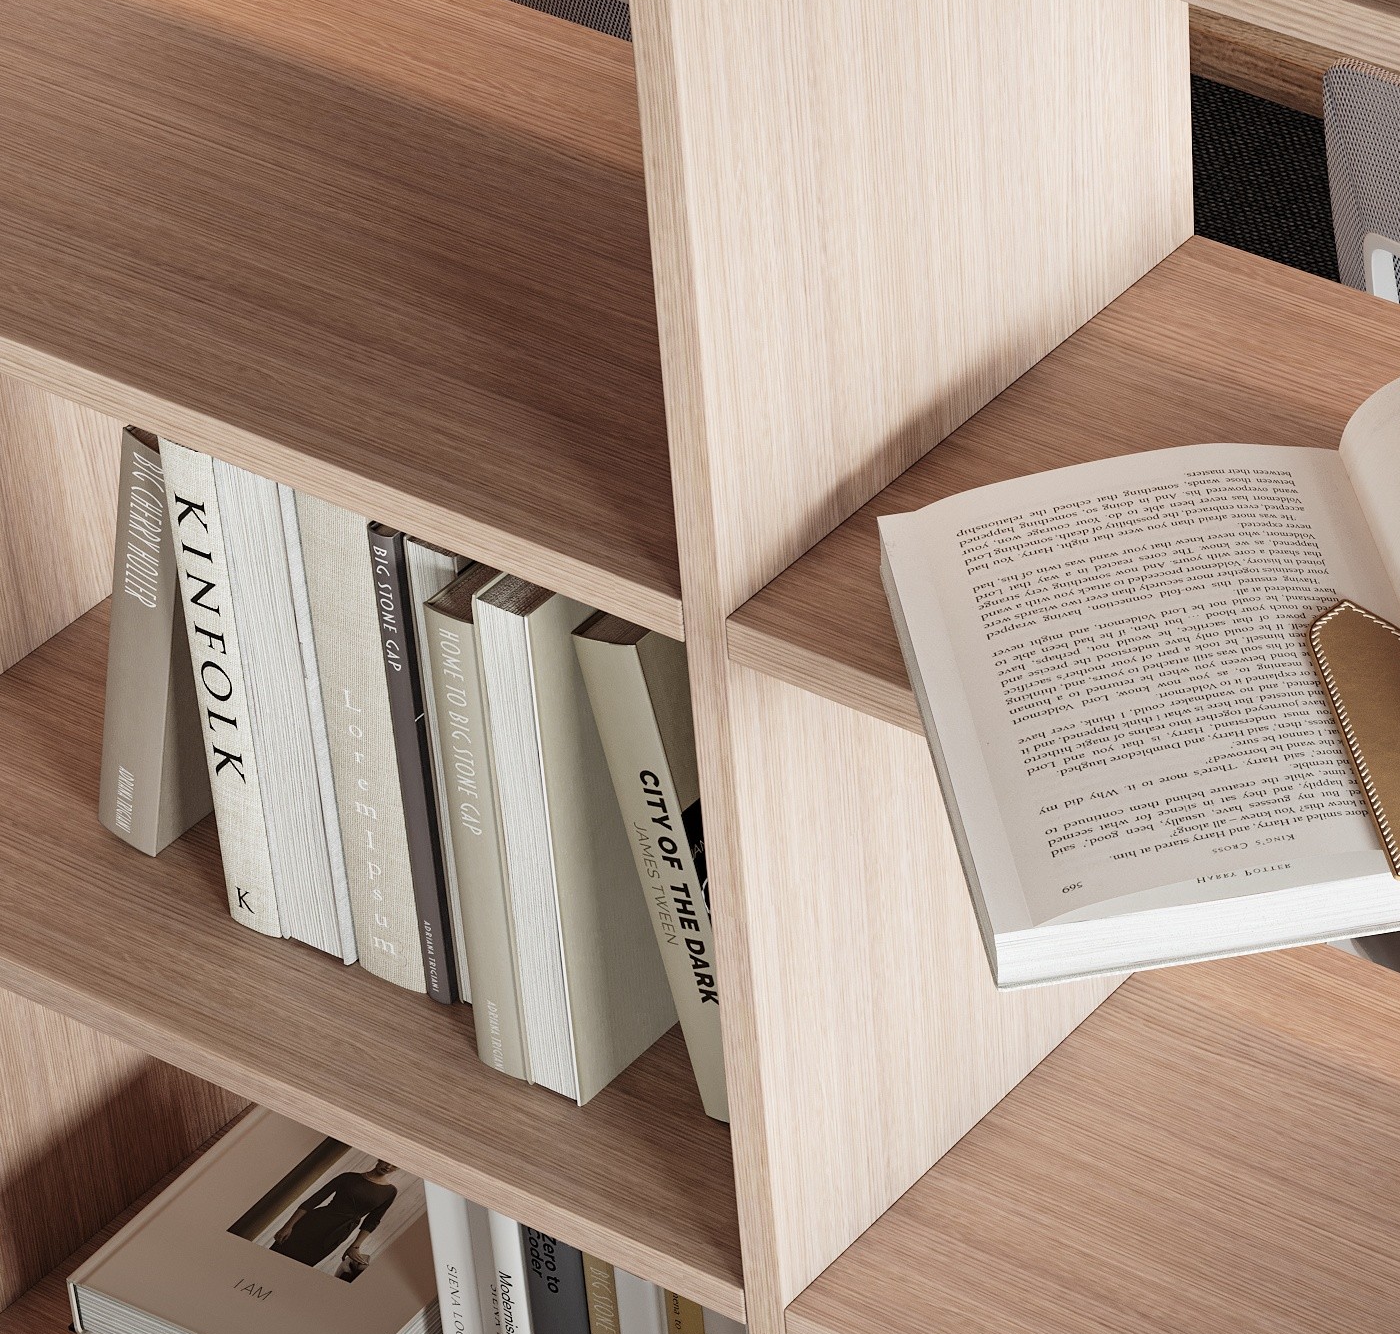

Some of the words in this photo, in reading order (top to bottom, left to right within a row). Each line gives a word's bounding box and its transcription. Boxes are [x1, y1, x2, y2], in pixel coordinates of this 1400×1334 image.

[373, 544, 390, 576] BIG
[377, 581, 397, 634] STONE
[174, 492, 247, 784] KINFOLK
[385, 639, 402, 672] GAP
[439, 627, 464, 686] HOME
[447, 685, 467, 707] TO
[449, 710, 472, 747] BIG
[452, 748, 478, 806] STONE
[461, 802, 482, 836] GAP
[639, 769, 673, 831] CITY
[657, 836, 684, 871] OF
[236, 886, 255, 914] K
[633, 821, 660, 879] JAMES
[652, 884, 679, 946] TWEEN
[670, 882, 700, 933] THE
[684, 938, 720, 1005] DARK
[233, 1278, 244, 1289] I
[240, 1283, 273, 1301] AM
[446, 1264, 461, 1308] SIENA
[547, 1275, 561, 1294] to
